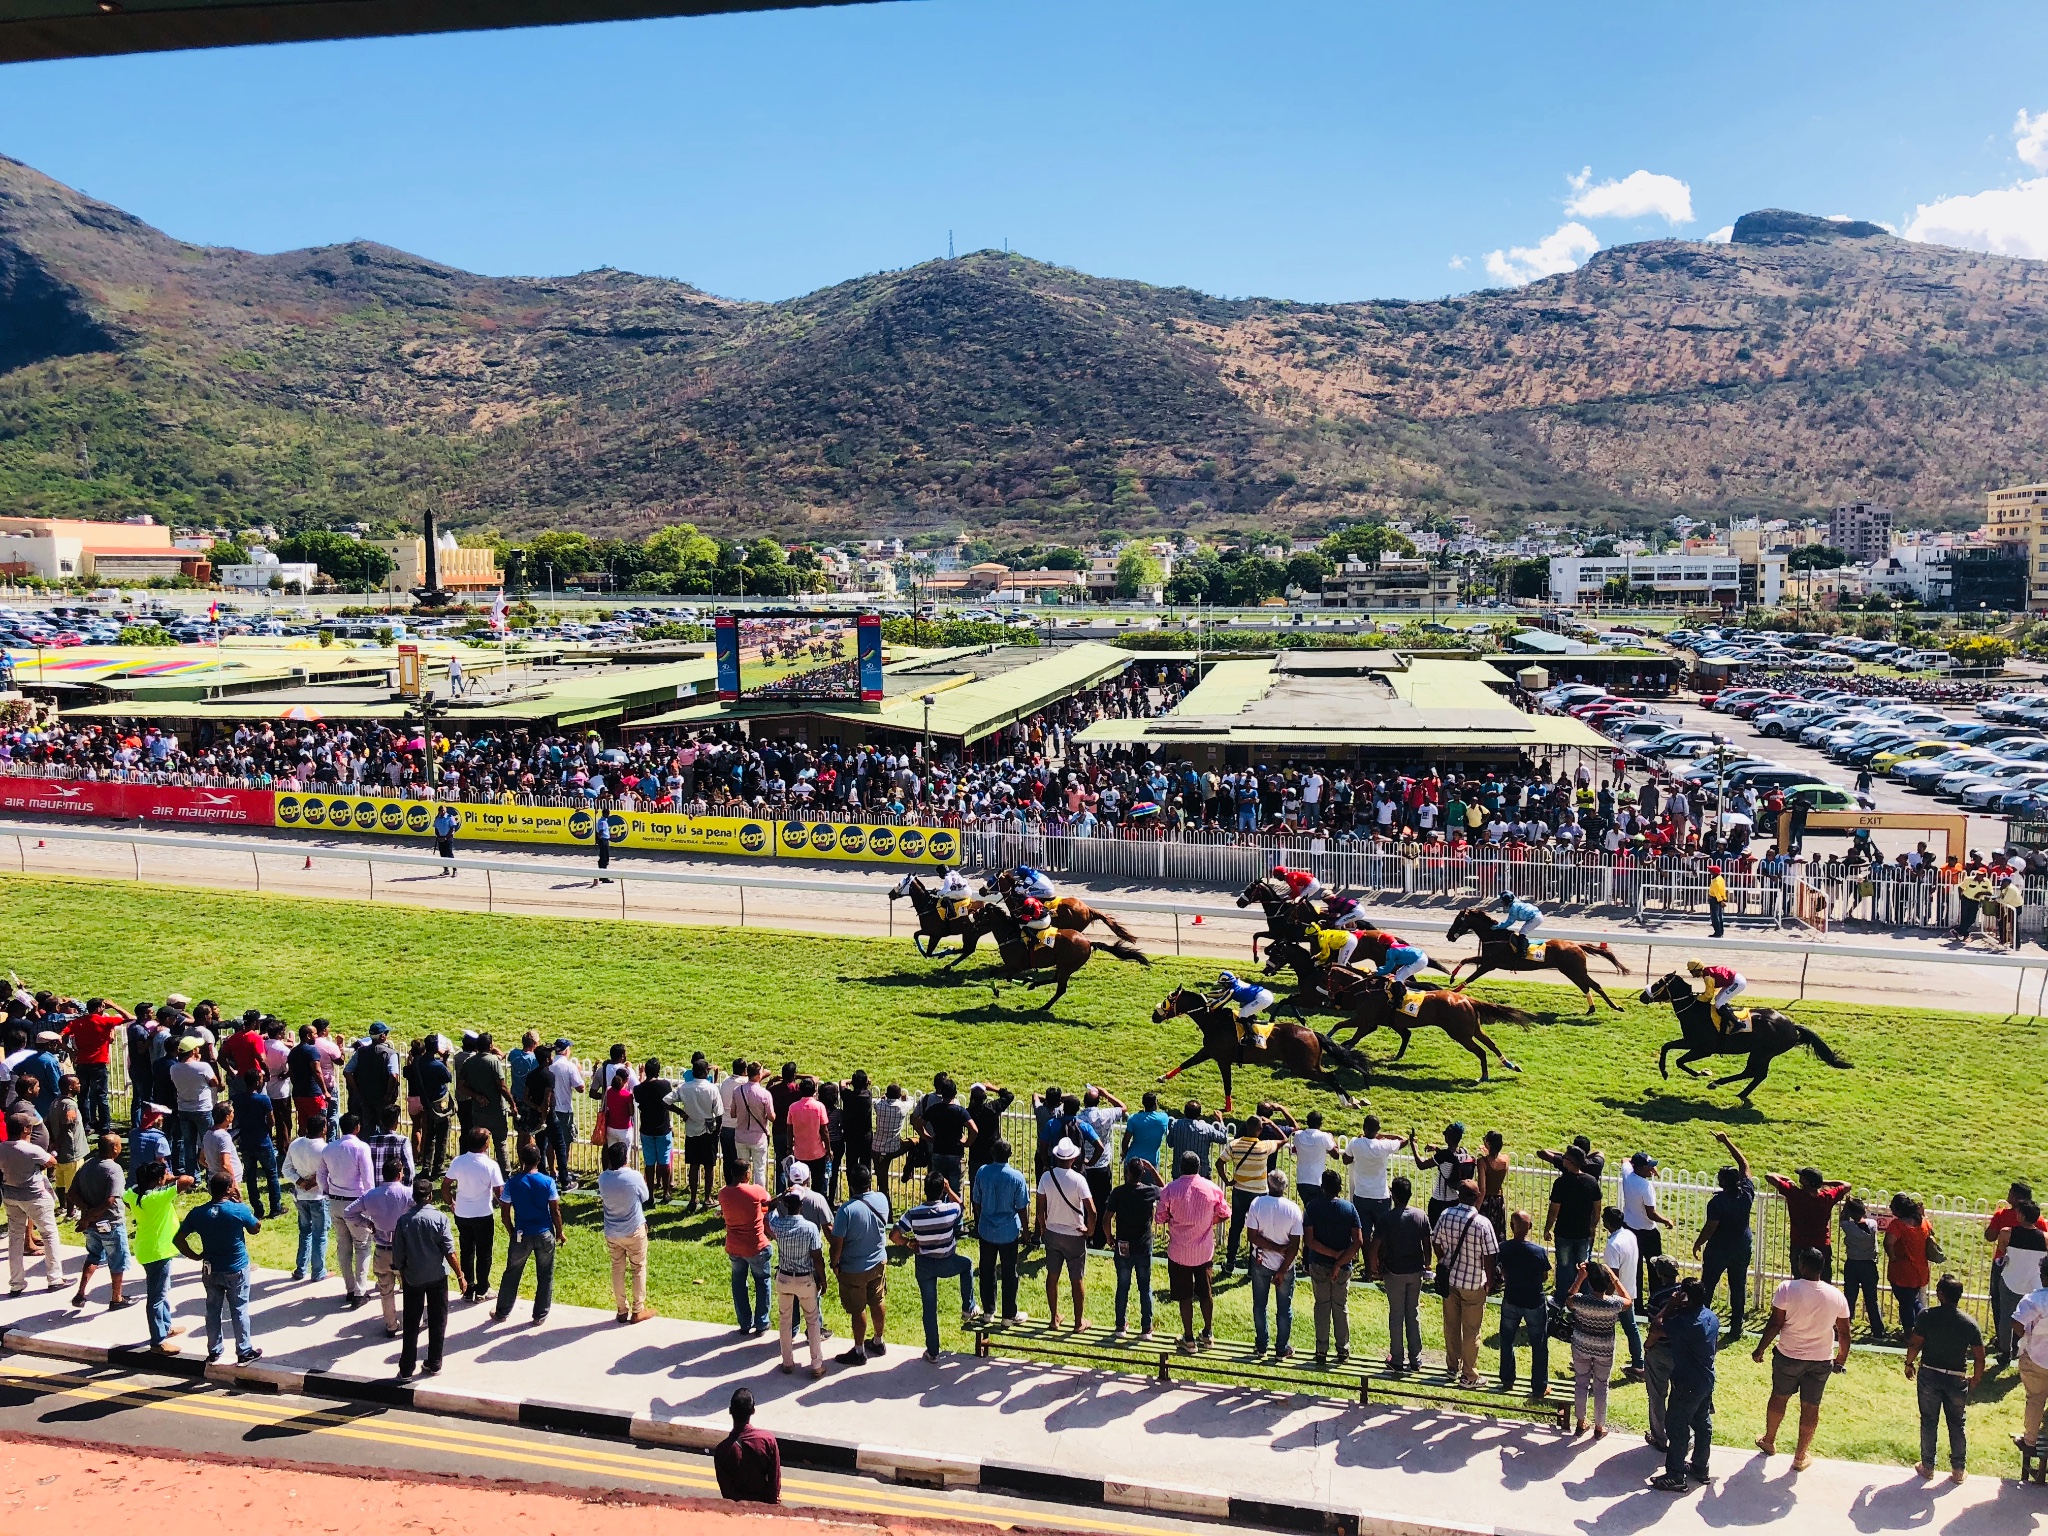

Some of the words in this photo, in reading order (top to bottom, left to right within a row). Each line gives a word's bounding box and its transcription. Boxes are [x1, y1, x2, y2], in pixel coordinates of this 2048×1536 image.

[279, 804, 300, 817] top
[304, 806, 326, 819] top
[329, 807, 352, 821] top
[355, 809, 378, 823] top
[381, 811, 404, 825] top
[464, 811, 478, 823] Pli
[507, 814, 518, 825] ki
[521, 817, 534, 825] sa
[406, 813, 431, 827] top
[569, 819, 594, 834] top
[1859, 816, 1883, 825] EXIT
[632, 820, 645, 833] Pli
[676, 824, 687, 835] ki
[690, 827, 703, 836] sa
[740, 831, 765, 846] top
[783, 828, 809, 844] top
[811, 830, 837, 847] top
[840, 832, 866, 849] top
[870, 834, 895, 851] top
[900, 836, 926, 853] top
[929, 838, 956, 856] top
